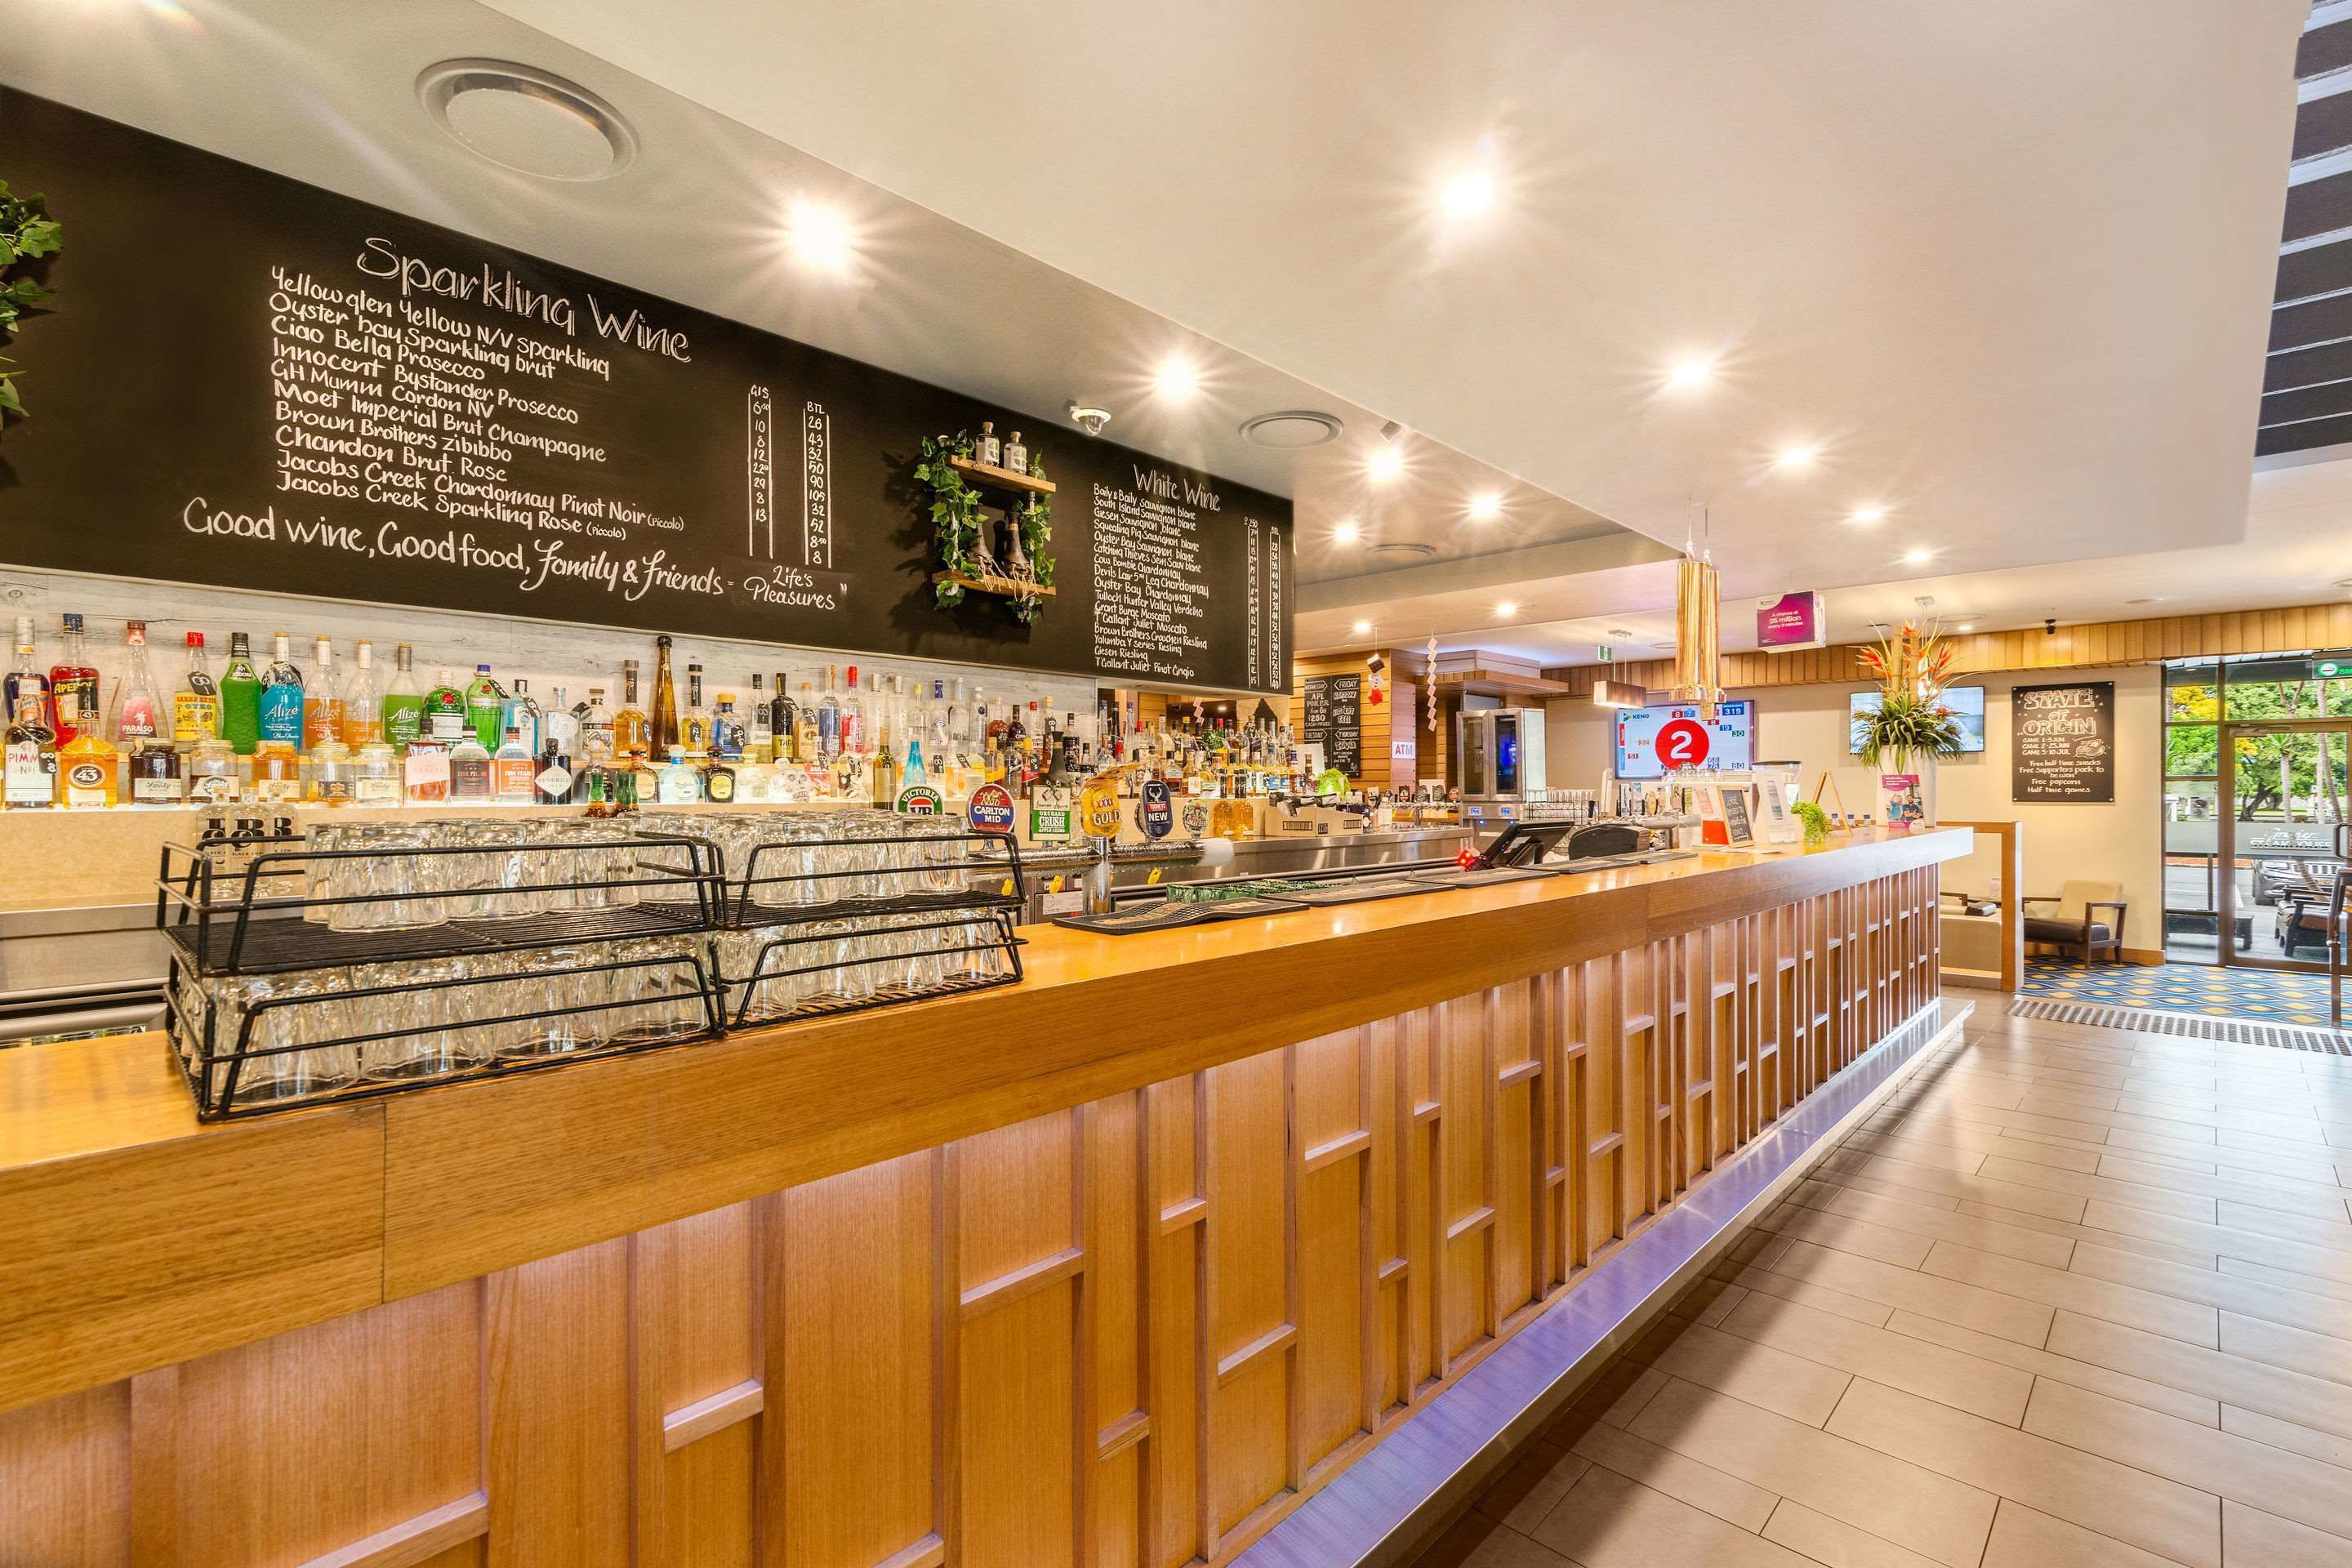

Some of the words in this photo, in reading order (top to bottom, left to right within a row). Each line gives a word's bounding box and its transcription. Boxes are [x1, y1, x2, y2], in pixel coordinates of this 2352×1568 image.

[357, 238, 575, 336] Sparkling
[587, 293, 692, 363] Wine
[271, 265, 343, 303] Yellow
[399, 299, 470, 337] Yellow
[477, 325, 514, 348] N/V
[516, 336, 610, 381] sparkling
[269, 292, 350, 326] Oyster
[358, 314, 402, 344] bay
[404, 327, 510, 373] Sparkling
[515, 353, 556, 379] brut
[271, 314, 324, 344] Ciao
[335, 328, 392, 360] Bella
[398, 344, 486, 380] Prosecco
[273, 336, 386, 377] Innocent
[394, 364, 494, 401] Bystander
[497, 388, 579, 424] Prosecco
[391, 385, 461, 412] Cordon
[468, 399, 494, 419] NV
[807, 402, 825, 414] BTL
[274, 378, 345, 408] Moet
[351, 394, 437, 429] Imperial
[443, 413, 483, 436] Brut
[488, 423, 607, 462] Champagne
[275, 400, 354, 433] Brown
[360, 418, 438, 449] Brothers
[755, 420, 766, 433] 10
[808, 417, 822, 430] 26
[757, 436, 765, 448] 8
[808, 434, 823, 448] 43
[275, 425, 394, 462] Chandon
[403, 446, 452, 473] Brut
[461, 457, 507, 482] Rose
[754, 448, 768, 462] 12
[808, 449, 822, 461] 32
[809, 463, 824, 474] 50
[277, 449, 360, 479] Jacobs
[364, 462, 427, 490] Creek
[434, 474, 555, 513] Chardonnay
[561, 493, 607, 518] Pinot
[609, 501, 647, 524] Noir
[810, 477, 824, 489] 90
[1134, 464, 1181, 501] White
[1183, 478, 1221, 512] Wine
[276, 470, 360, 498] Jacobs
[365, 483, 429, 511] Creek
[435, 494, 532, 531] Sparkling
[538, 510, 582, 532] Rose
[756, 492, 764, 504] 8
[809, 492, 826, 502] 105
[755, 508, 767, 522] 13
[811, 505, 825, 516] 32
[1094, 496, 1116, 510] South
[1119, 502, 1140, 515] Island
[1140, 509, 1176, 525] Sauvignon
[1178, 519, 1196, 531] blanc
[1178, 506, 1196, 520] blanc
[810, 519, 824, 532] 52
[1120, 514, 1157, 531] Sauvignon
[1161, 523, 1181, 537] blanc
[183, 497, 275, 540] Good
[378, 520, 456, 564] Good
[623, 559, 638, 583] &
[1094, 519, 1129, 537] Squealing
[1143, 531, 1178, 547] Sauvignon
[1181, 538, 1200, 552] blanc
[1094, 531, 1120, 545] Oyster
[1121, 536, 1135, 550] Bay
[1137, 540, 1172, 557] Sauvignon
[1176, 548, 1194, 563] blanc
[1094, 542, 1123, 558] Catching
[1125, 547, 1150, 563] Thieves
[813, 551, 822, 564] 8
[1094, 564, 1116, 578] Devils
[1160, 577, 1209, 599] Chardonnay
[1138, 563, 1181, 584] Chardonnay
[743, 576, 835, 610] Pleasures
[1094, 577, 1122, 590] Oyster
[1125, 581, 1141, 598] Bay
[1145, 585, 1191, 605] Chardonnay
[1094, 600, 1117, 612] Grant
[1119, 604, 1138, 620] Burge
[1141, 608, 1170, 622] Moscato
[1095, 590, 1121, 604] Tulloch
[1124, 594, 1148, 608] Hunter
[1149, 598, 1172, 614] Valley
[1174, 603, 1203, 617] Verdelho
[1133, 617, 1154, 630] Juliet
[1156, 621, 1187, 635] Moscato
[1094, 622, 1120, 635] Brown
[1121, 626, 1150, 640] Brothers
[1183, 635, 1207, 650] Riesling
[1094, 634, 1126, 647] Yalumba
[1159, 642, 1182, 657] Riesling
[1120, 648, 1148, 662] Riesling
[1130, 660, 1152, 672] Juliet
[1154, 662, 1172, 675] Pinot
[2024, 688, 2095, 710] STATE
[2048, 709, 2070, 721] OF
[2023, 716, 2096, 735] ORIGIN
[1395, 744, 1413, 755] ATM
[1670, 730, 1692, 759] 2
[74, 769, 99, 782] 43
[902, 788, 939, 803] VICTORIA
[1097, 799, 1114, 808] XXXX
[974, 805, 1010, 816] CARLTON
[984, 815, 1001, 823] MID
[1092, 809, 1121, 826] GOLD
[1148, 813, 1168, 822] NEW
[1039, 817, 1065, 827] CRUSH
